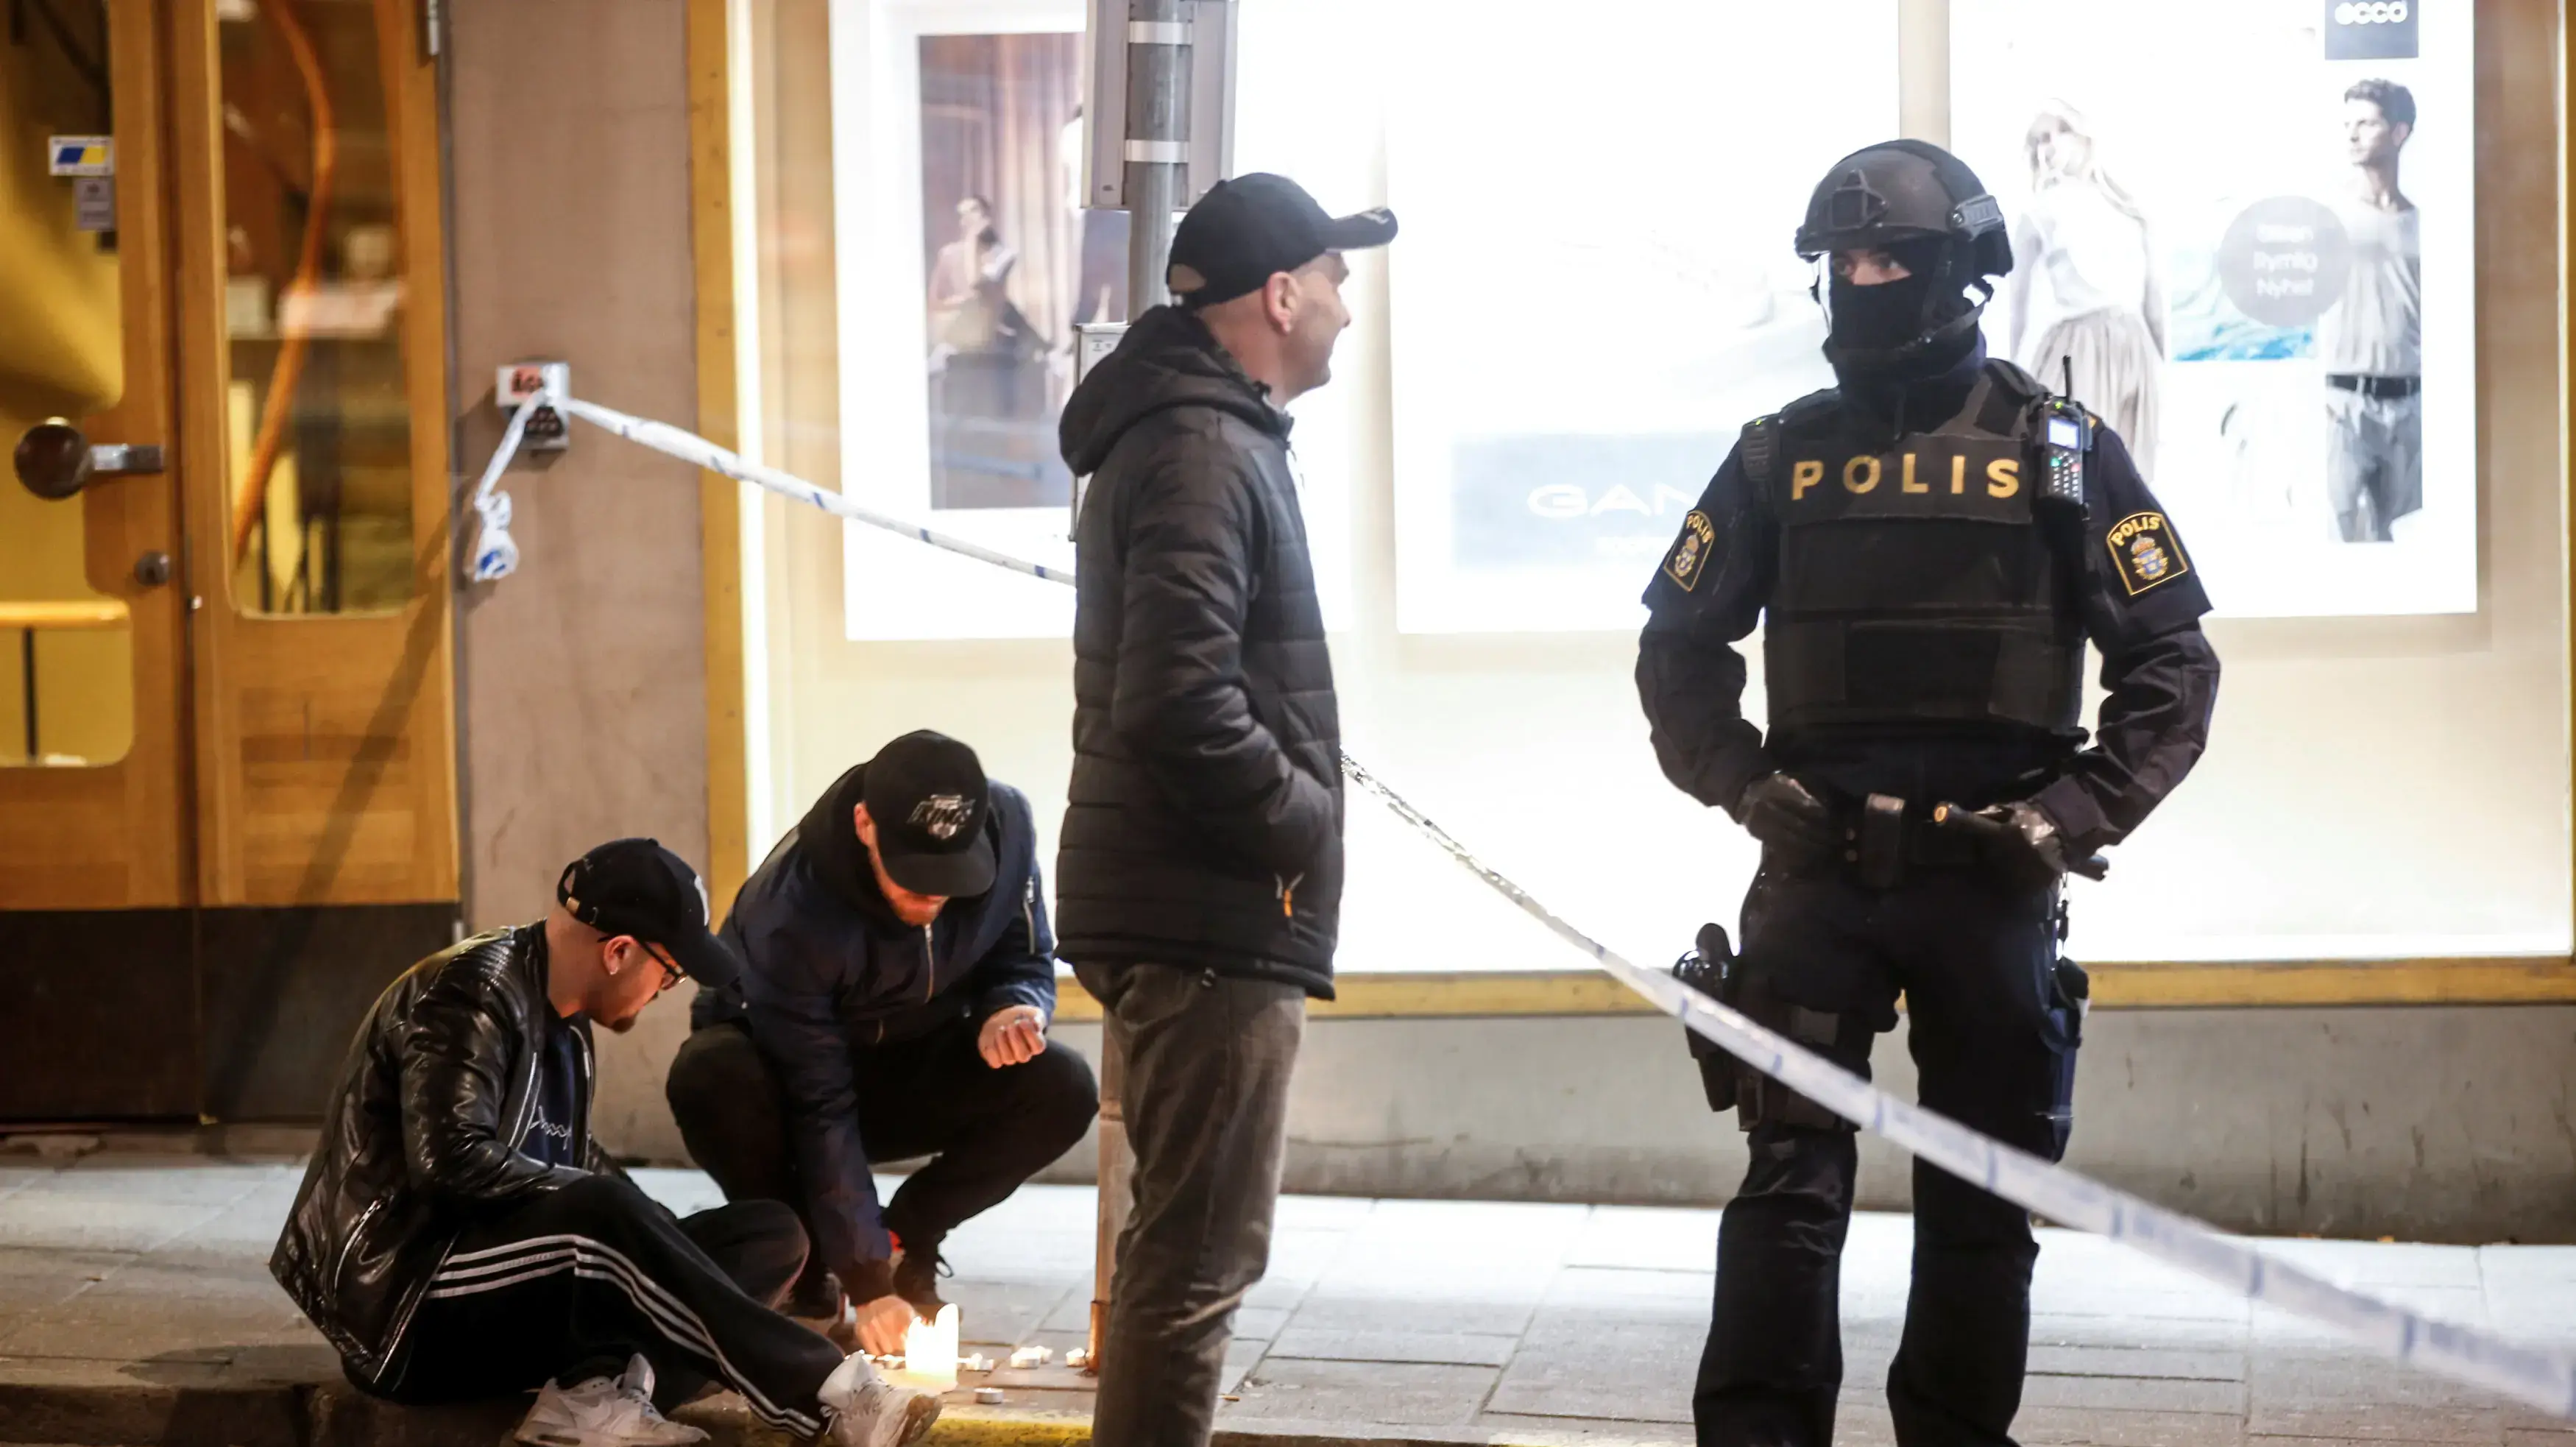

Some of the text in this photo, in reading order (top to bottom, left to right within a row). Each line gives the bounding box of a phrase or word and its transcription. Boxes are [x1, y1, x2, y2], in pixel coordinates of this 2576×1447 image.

[2335, 1, 2407, 25] ecco
[1791, 453, 2020, 500] POLIS
[1526, 481, 1697, 518] GAN
[1686, 514, 1713, 544] POLIS
[2111, 516, 2162, 546] POLIS
